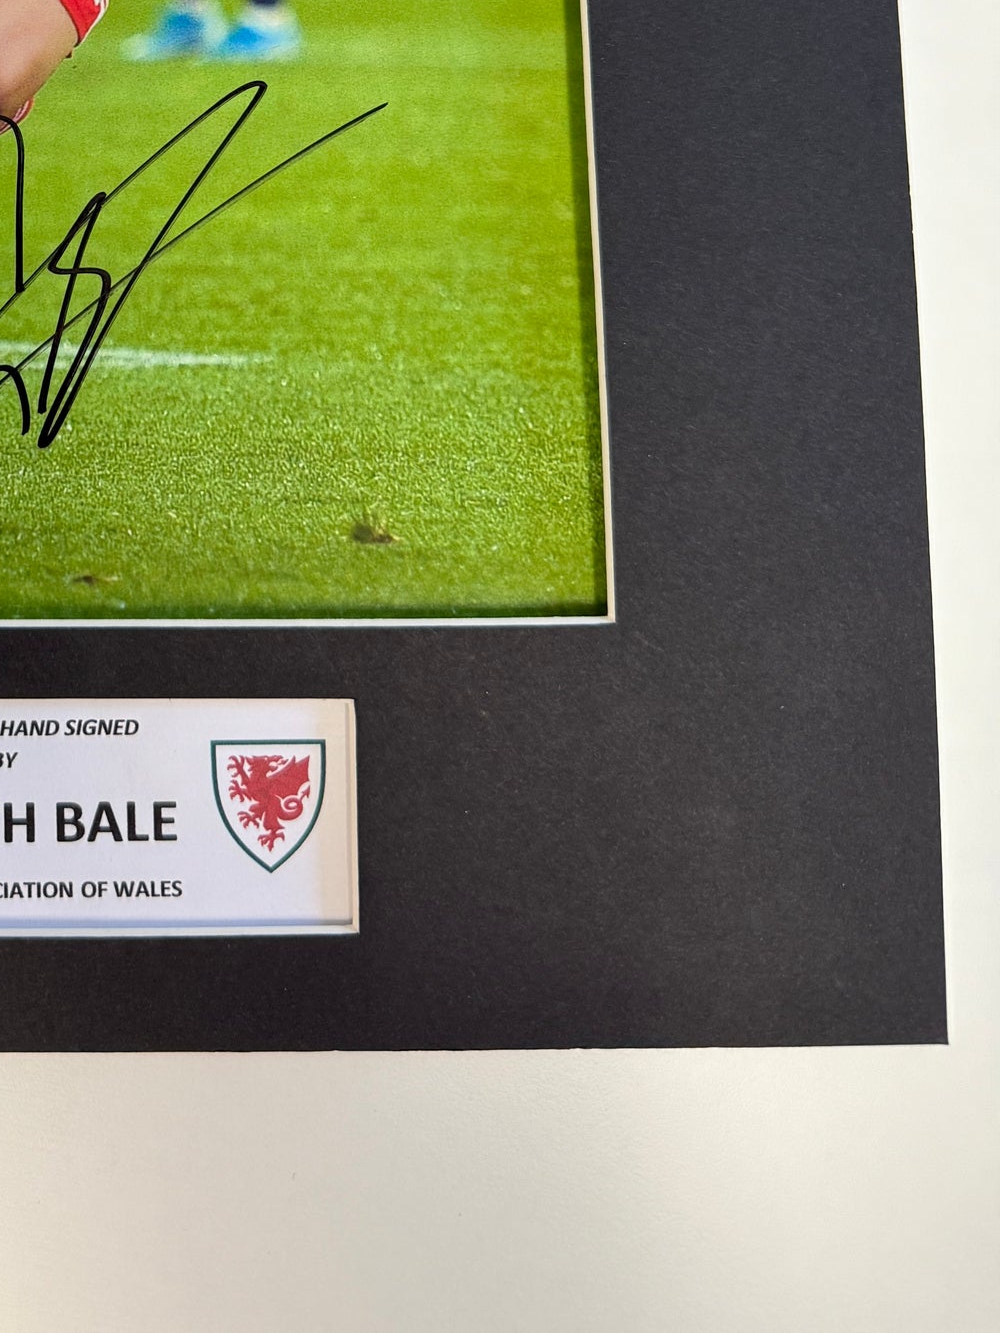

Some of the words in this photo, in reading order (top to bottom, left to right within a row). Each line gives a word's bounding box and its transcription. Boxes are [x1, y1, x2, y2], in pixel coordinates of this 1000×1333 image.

[0, 720, 60, 736] HAND
[64, 719, 139, 736] SIGNED
[56, 801, 178, 842] BALE
[81, 881, 108, 898] OF
[114, 880, 183, 897] WALES
